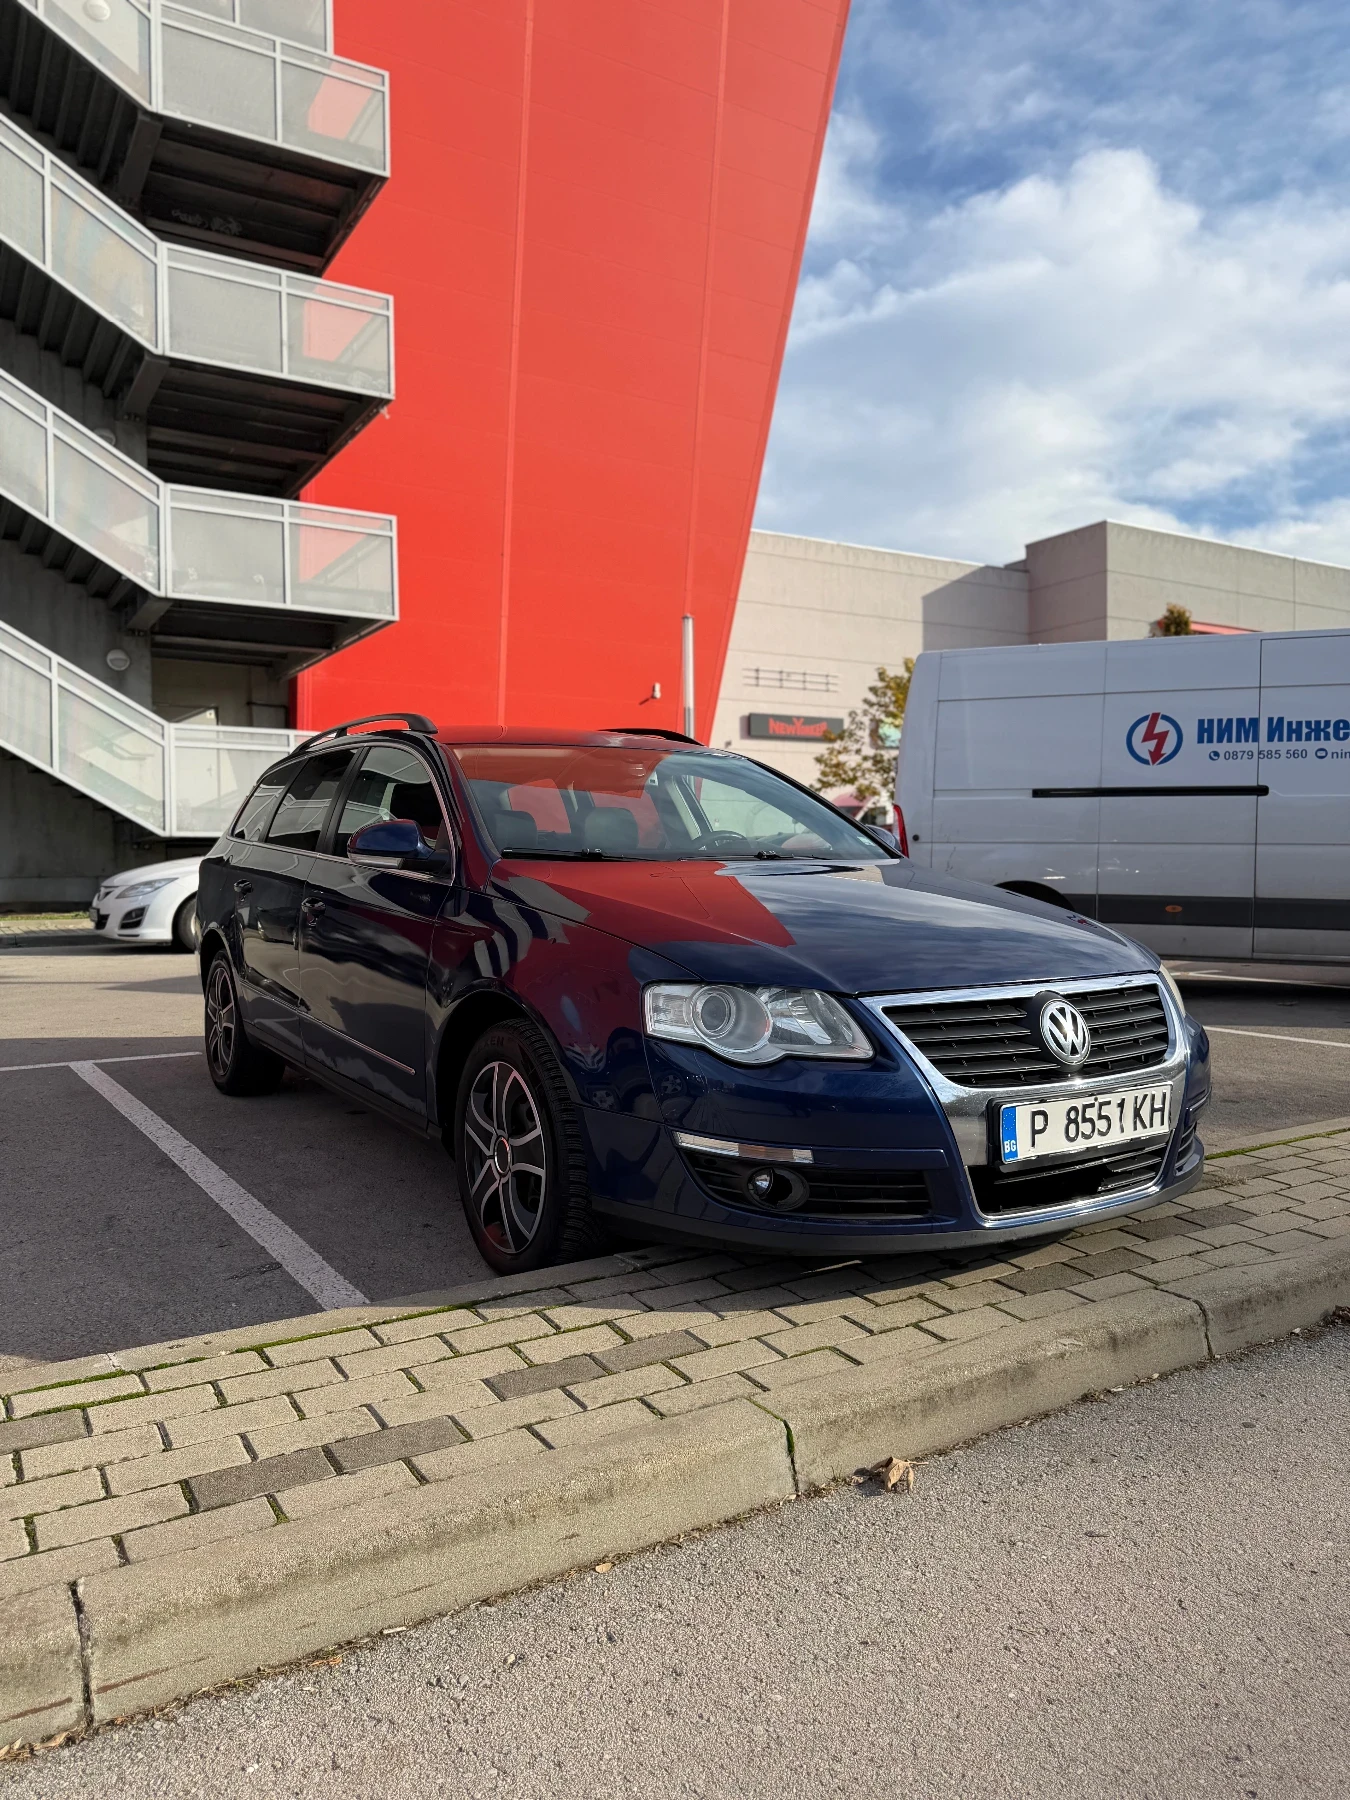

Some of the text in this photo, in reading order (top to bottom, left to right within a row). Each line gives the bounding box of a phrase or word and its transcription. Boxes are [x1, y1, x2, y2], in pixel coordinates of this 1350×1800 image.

[1197, 717, 1259, 744] НИМ
[1224, 749, 1308, 761] 0879 585 560
[1031, 1091, 1167, 1148] P 8551 KH
[1004, 1139, 1016, 1153] BG
